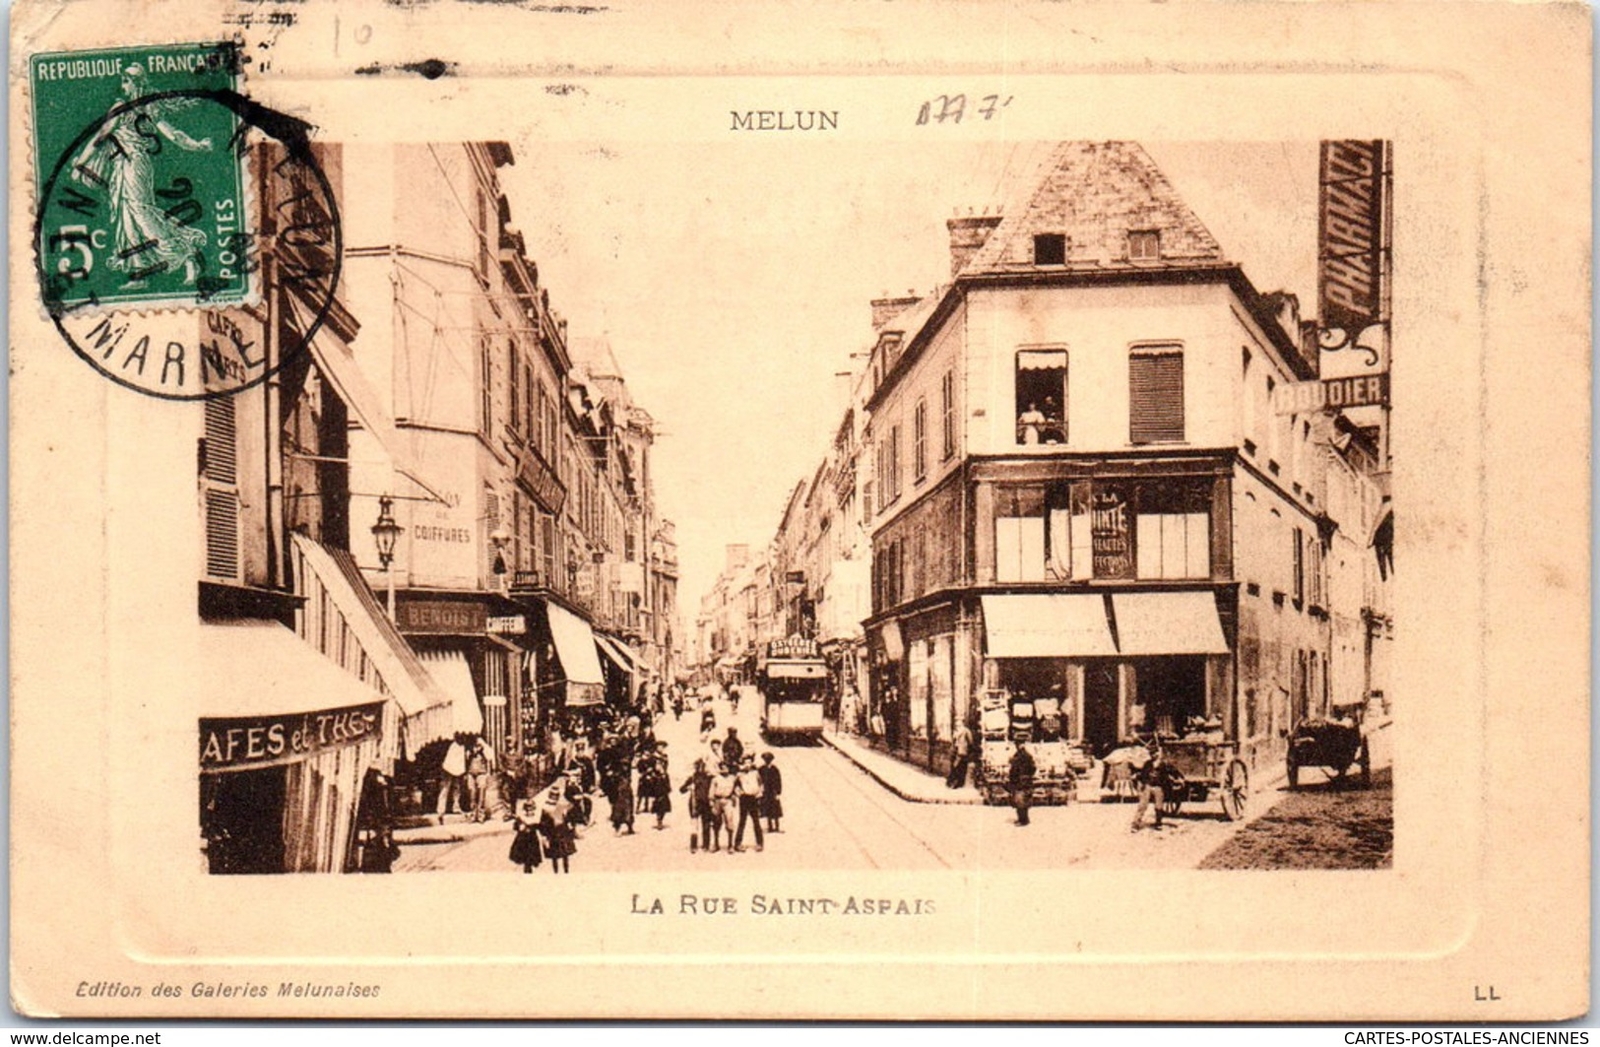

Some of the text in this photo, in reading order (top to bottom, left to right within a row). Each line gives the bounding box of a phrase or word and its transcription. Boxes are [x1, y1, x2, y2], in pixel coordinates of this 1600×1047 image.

[148, 53, 224, 74] FRANÇA
[729, 110, 839, 130] MELUN
[215, 198, 237, 280] POSTES
[1325, 141, 1372, 316] PHARMACI
[85, 303, 266, 386] MARNE
[414, 525, 470, 543] COIFFURES
[408, 605, 481, 627] BENOIST
[291, 715, 309, 751] et
[630, 894, 664, 914] LA
[679, 894, 738, 914] RUE
[151, 982, 182, 998] des
[191, 982, 268, 998] Galeries
[277, 982, 381, 998] Melunaises
[1474, 985, 1501, 1001] LL
